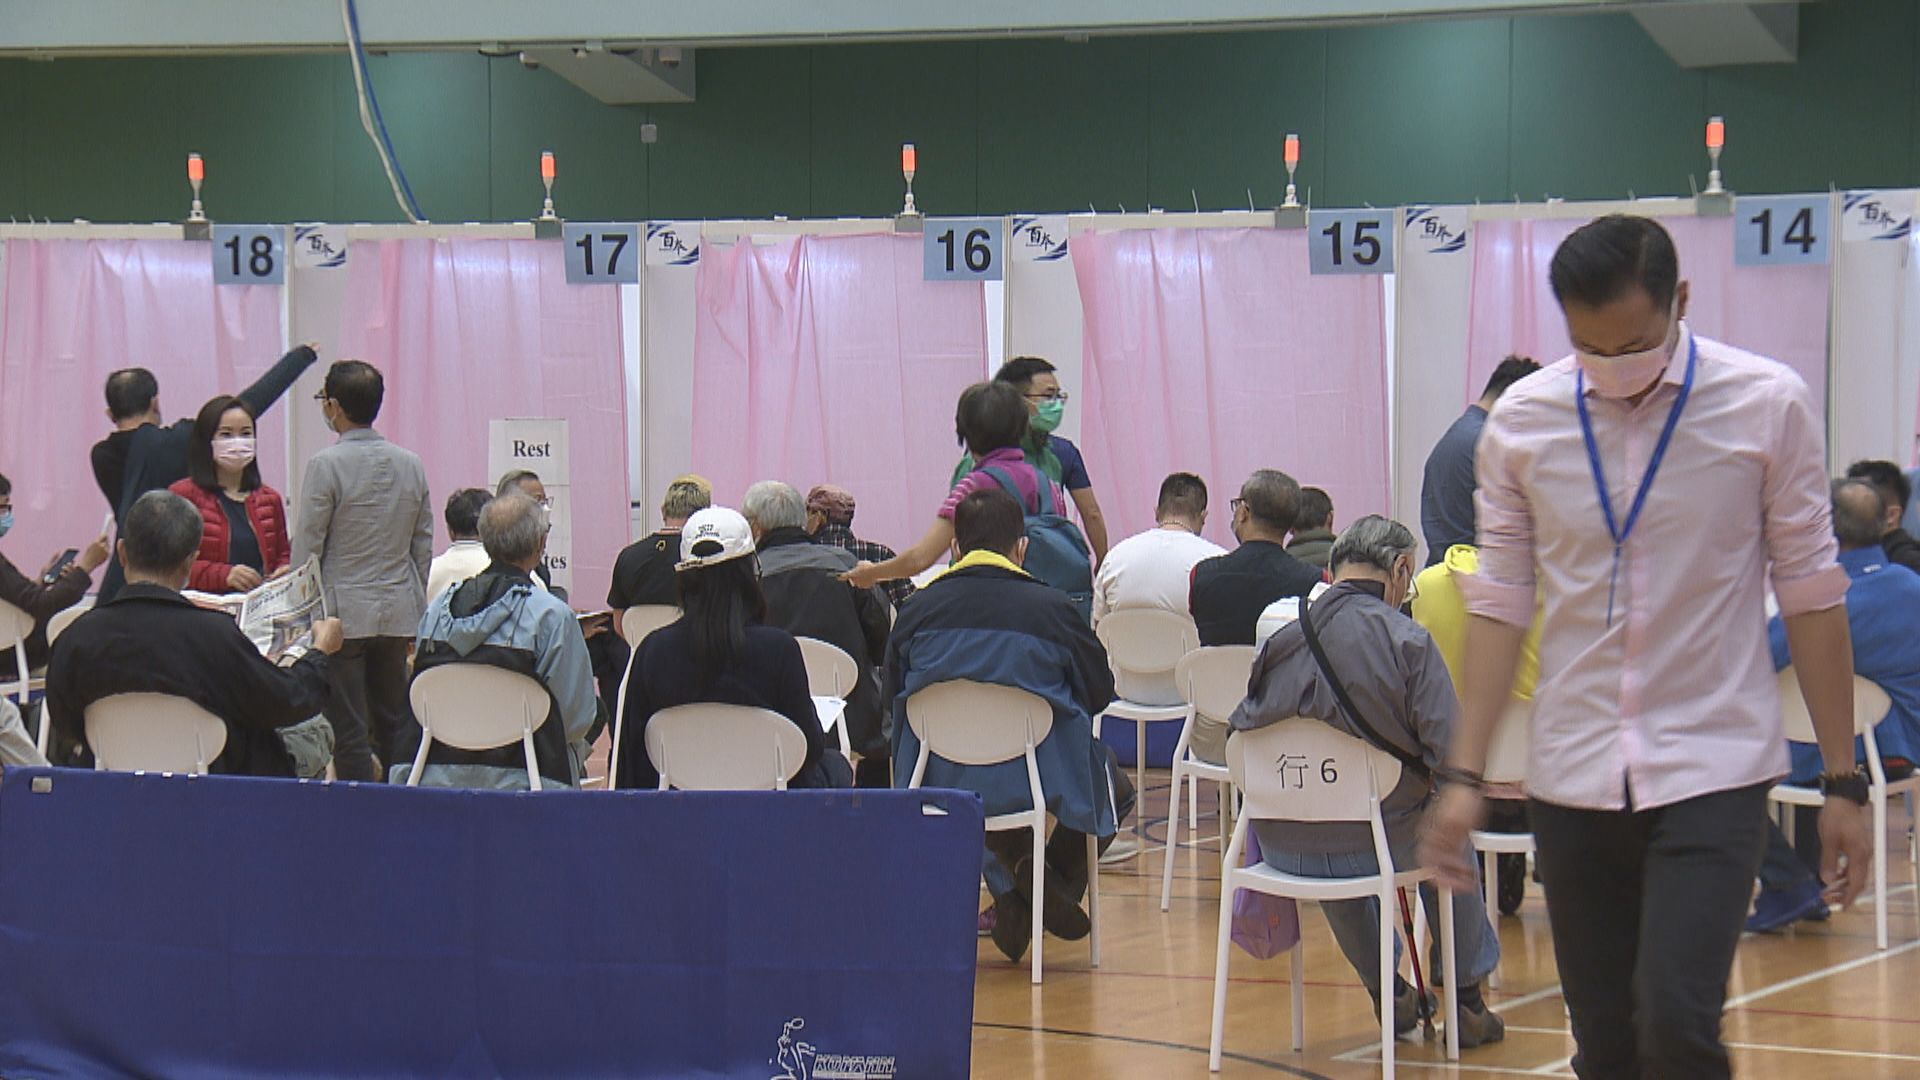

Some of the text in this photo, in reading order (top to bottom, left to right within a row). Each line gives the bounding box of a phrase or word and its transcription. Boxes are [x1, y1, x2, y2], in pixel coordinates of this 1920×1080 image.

[937, 227, 991, 273] 16
[1322, 220, 1381, 266] 15
[1751, 207, 1816, 255] 14
[224, 235, 274, 277] 18
[576, 233, 628, 276] 17
[512, 440, 551, 457] Rest
[1276, 753, 1338, 789] 行 6
